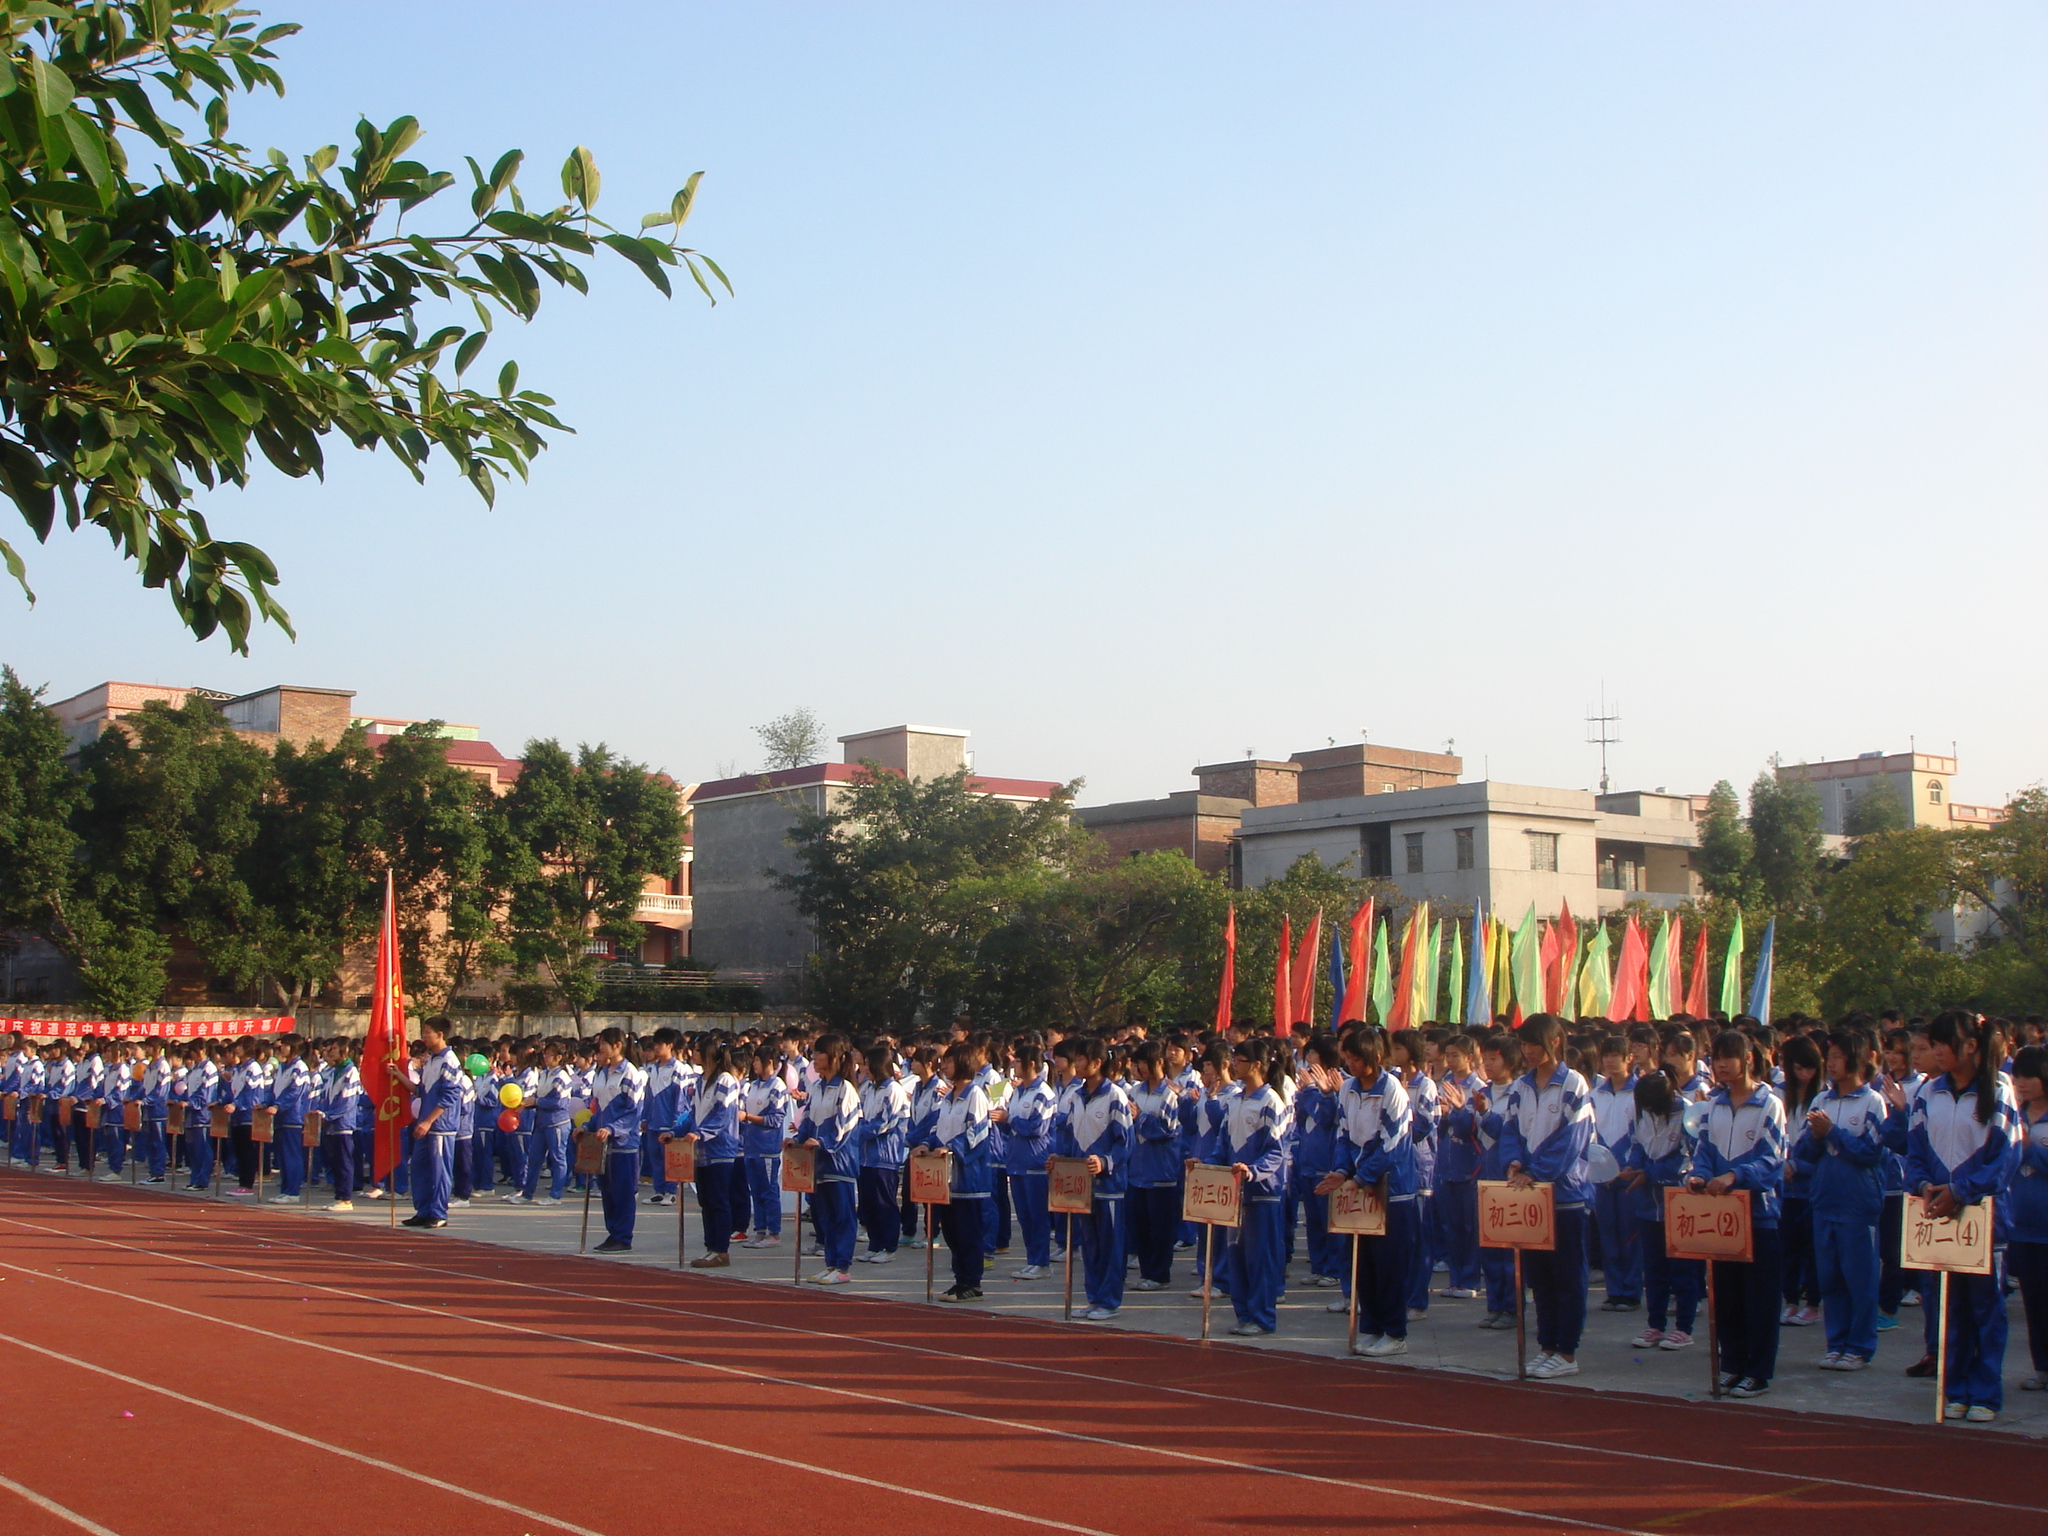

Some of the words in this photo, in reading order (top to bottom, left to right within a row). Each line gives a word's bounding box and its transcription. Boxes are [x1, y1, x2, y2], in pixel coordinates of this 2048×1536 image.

[915, 1165, 944, 1188] 初三(1)
[1055, 1171, 1087, 1196] 初三(3)
[1191, 1179, 1232, 1207] 初三(5)
[1488, 1198, 1543, 1229] 初三(9)
[1676, 1206, 1739, 1238] 初二(2)
[1914, 1212, 1979, 1248] 初二(4)
